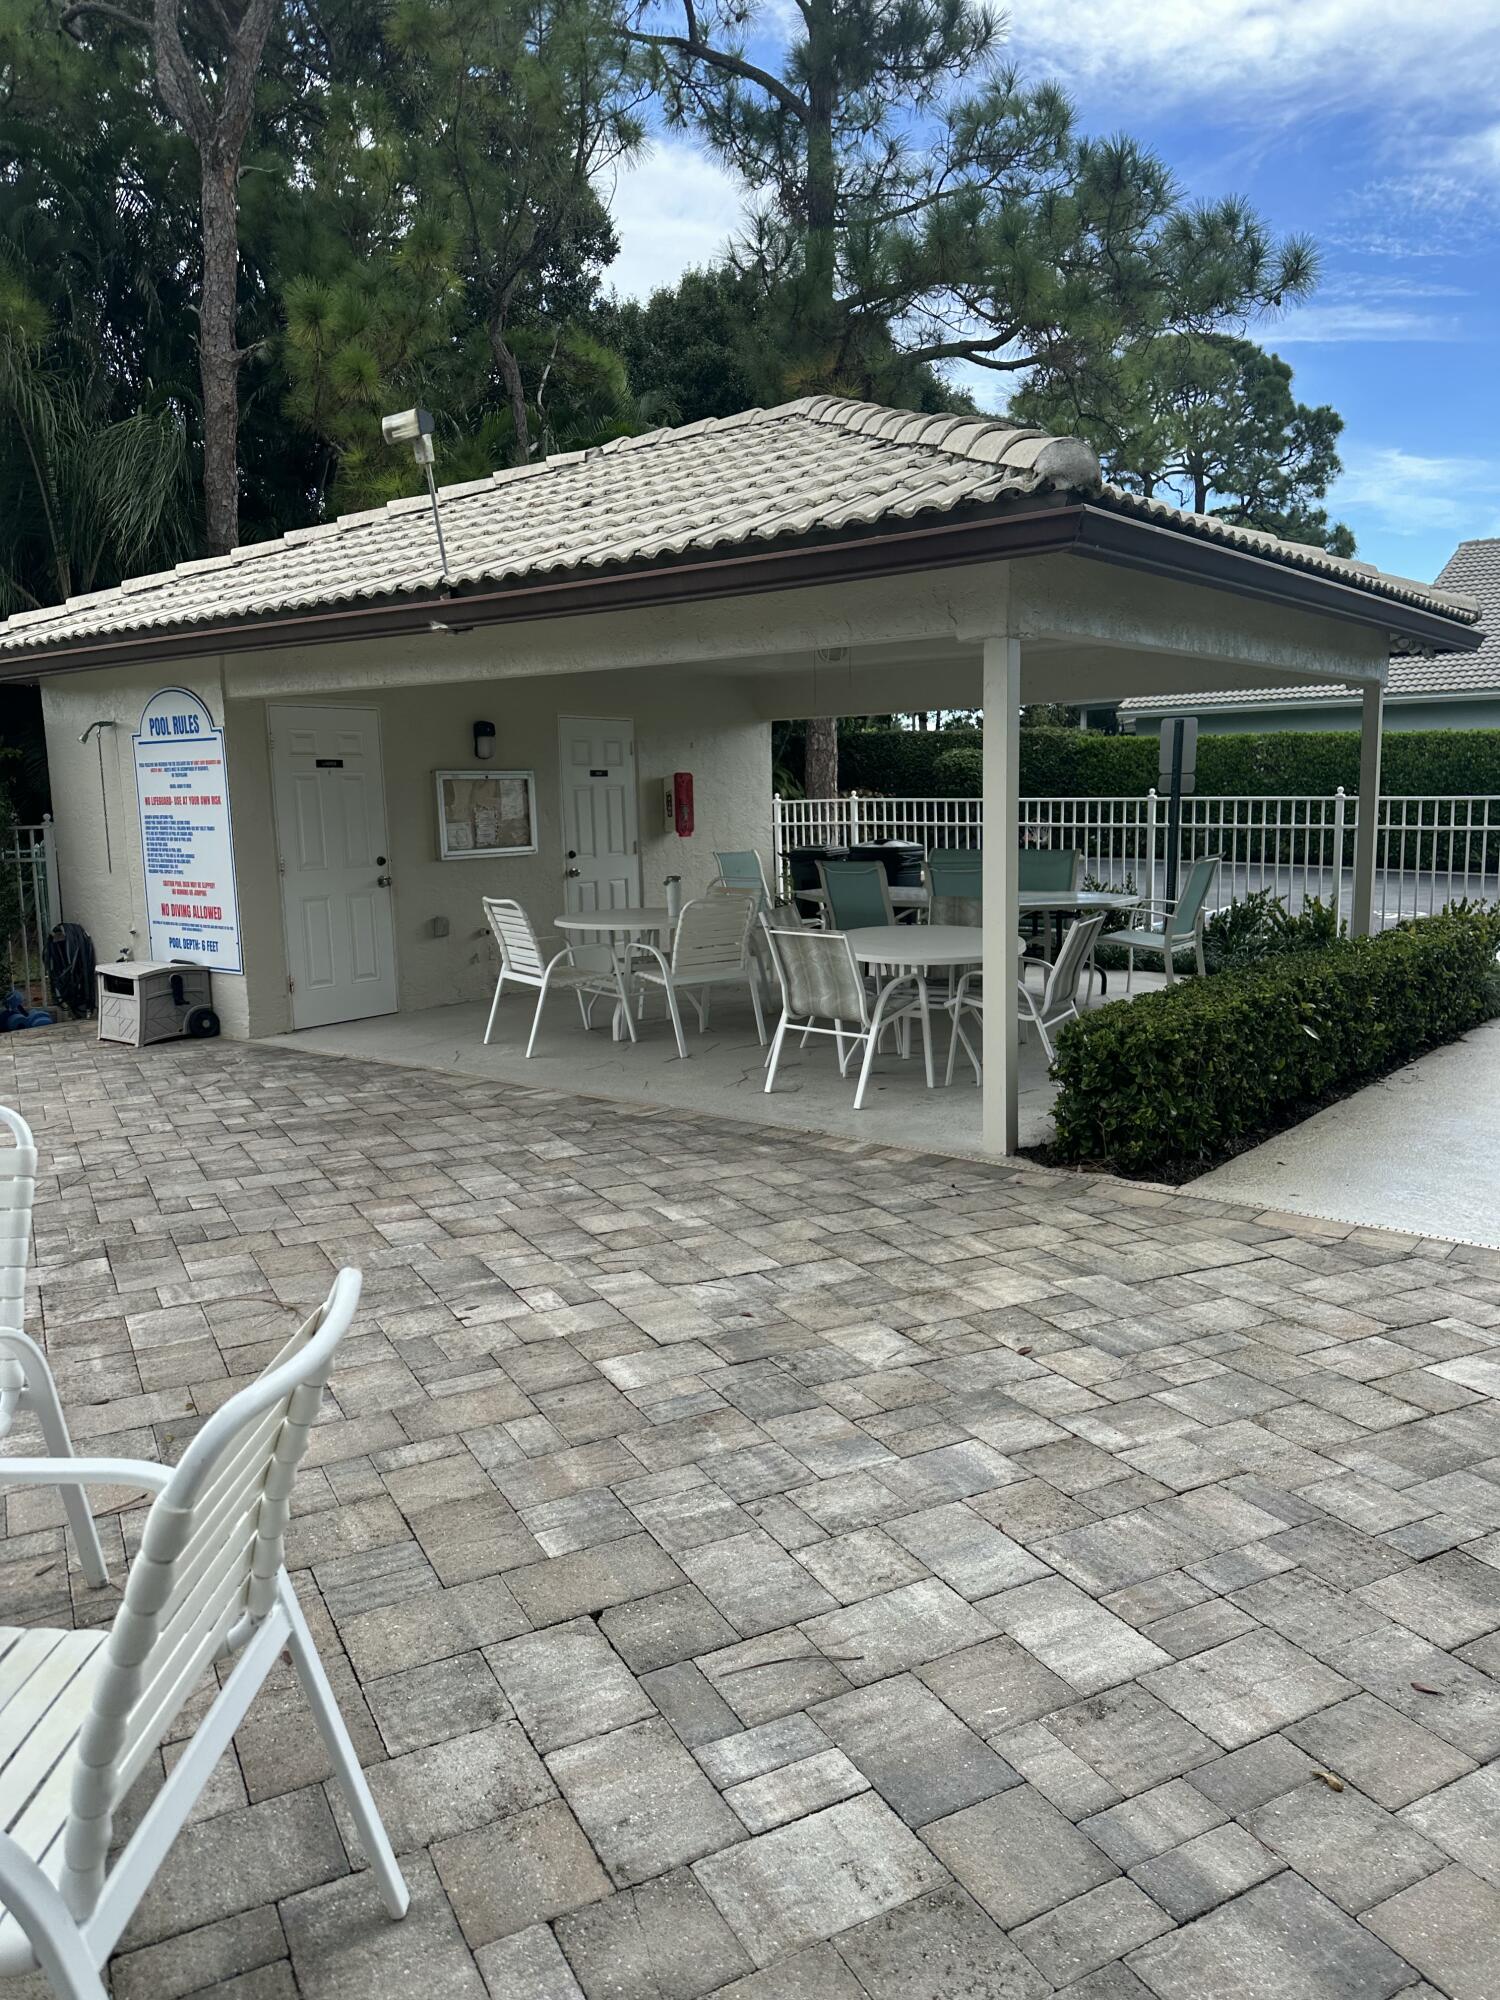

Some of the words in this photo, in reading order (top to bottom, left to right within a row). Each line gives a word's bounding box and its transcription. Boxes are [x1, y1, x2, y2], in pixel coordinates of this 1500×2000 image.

[149, 717, 171, 736] POOL
[172, 714, 199, 735] RULES
[173, 796, 182, 805] USE
[182, 796, 188, 805] AT
[188, 796, 199, 805] YOUR
[200, 796, 210, 805] OWN
[211, 796, 221, 805] RISK
[161, 904, 170, 916] NO
[171, 904, 191, 918] DIVING
[193, 905, 222, 920] ALLOWED
[169, 937, 182, 949] POOL
[183, 939, 200, 951] DEPTH:
[202, 940, 206, 951] 6
[207, 941, 218, 952] FEET
